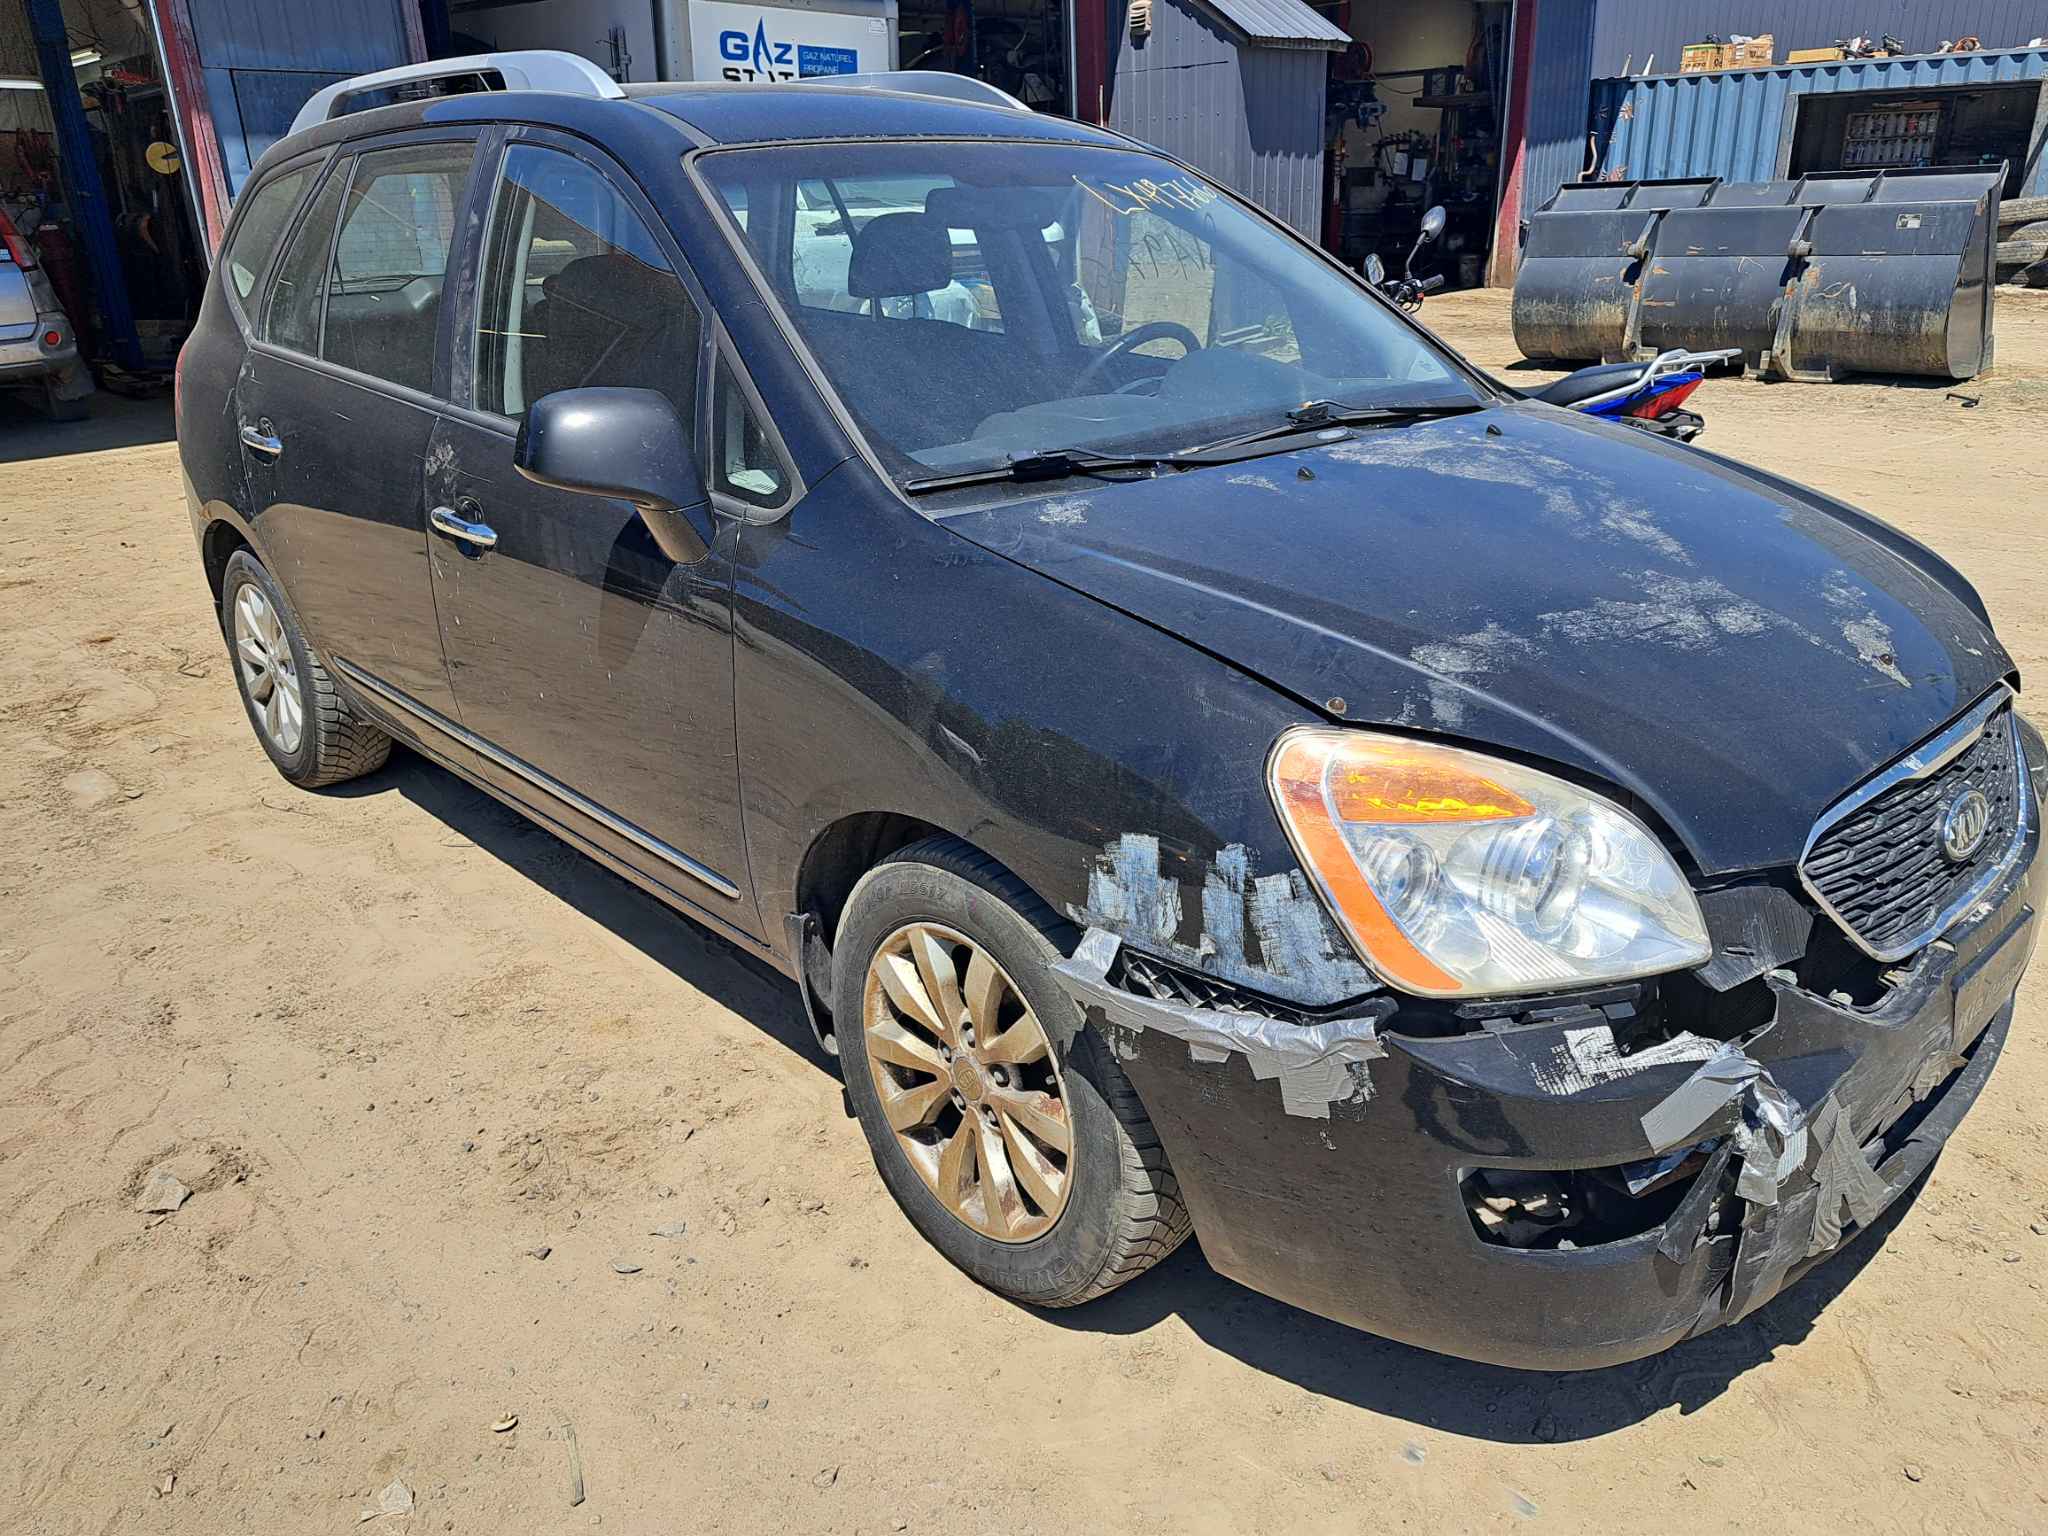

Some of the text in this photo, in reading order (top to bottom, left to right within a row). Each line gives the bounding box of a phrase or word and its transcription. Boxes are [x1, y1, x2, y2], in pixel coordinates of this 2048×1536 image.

[719, 15, 793, 74] GAZ
[802, 51, 818, 62] GAZ
[803, 64, 839, 74] PROPANE
[1949, 797, 1985, 853] KIA
